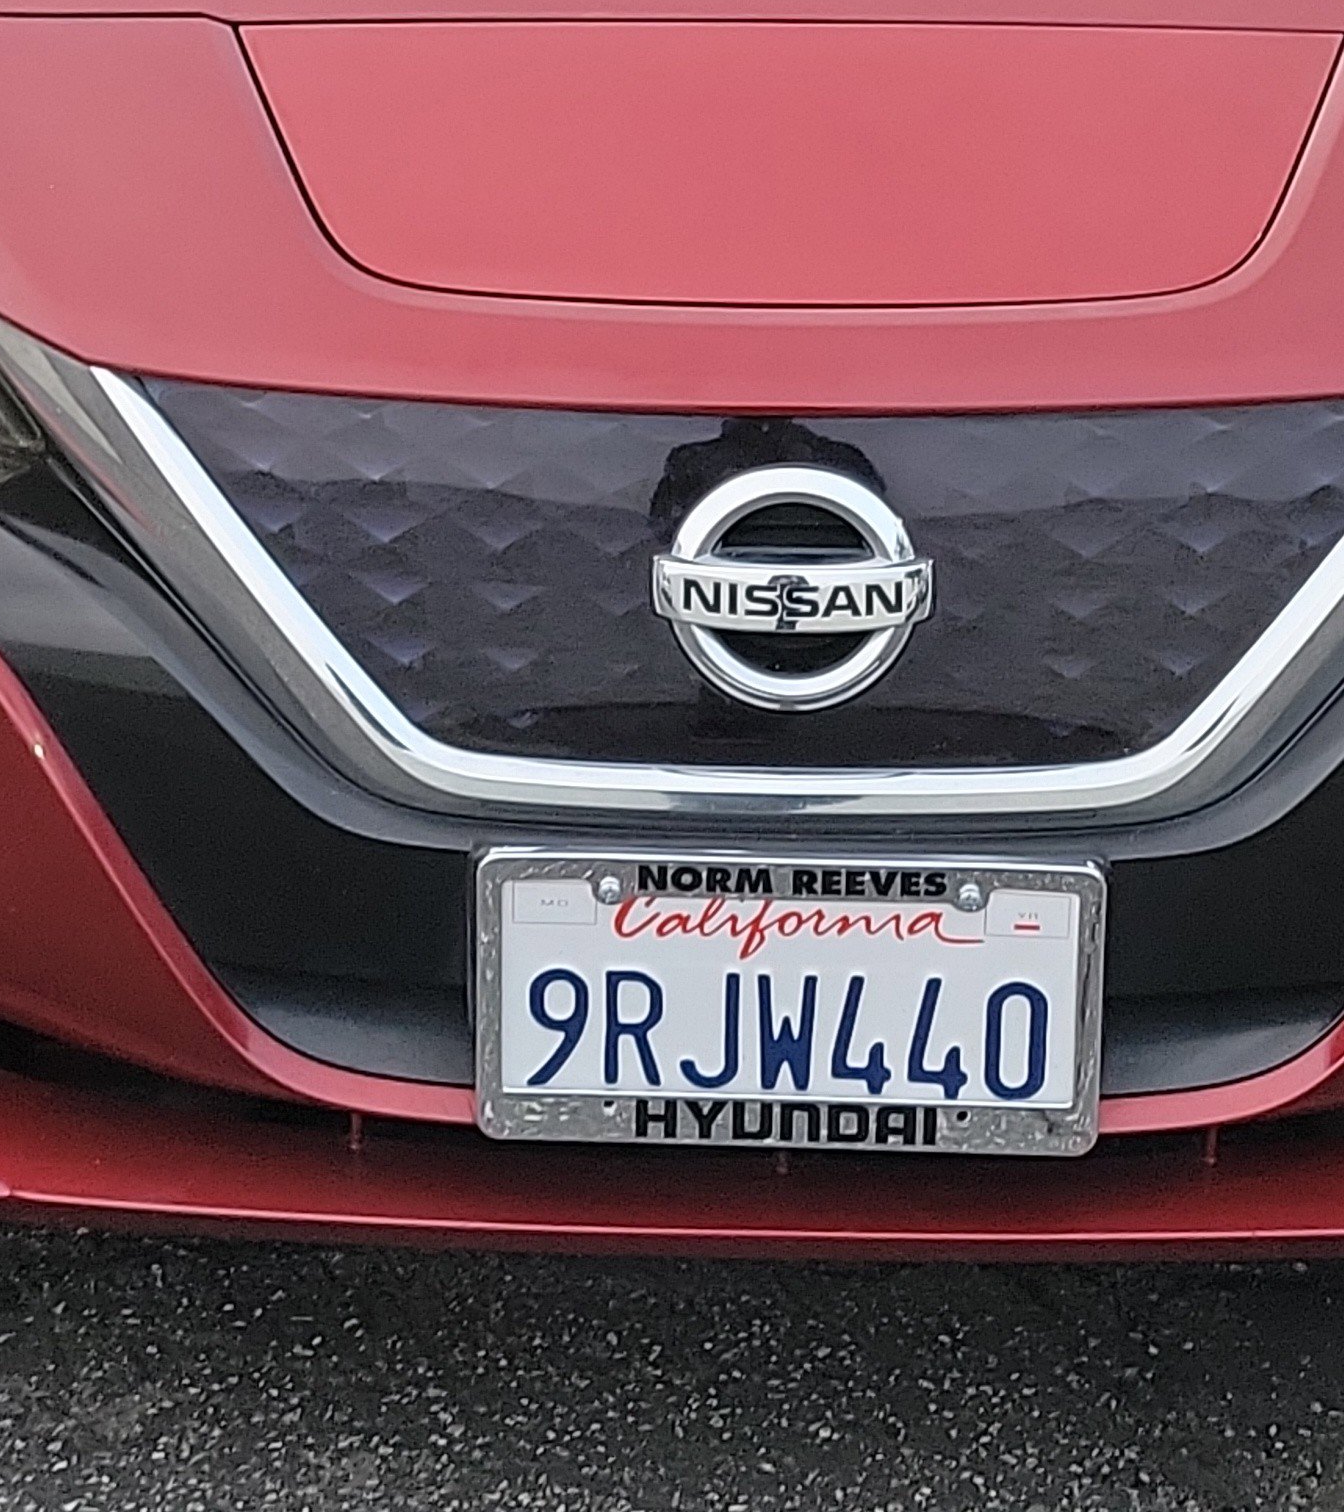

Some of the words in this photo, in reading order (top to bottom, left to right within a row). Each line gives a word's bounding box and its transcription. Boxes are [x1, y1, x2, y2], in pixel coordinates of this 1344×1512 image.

[682, 578, 904, 619] NISSAN
[637, 864, 772, 896] NORM
[791, 869, 948, 898] REEVES
[613, 895, 985, 959] California
[525, 968, 1050, 1101] 9RJW440
[634, 1099, 937, 1146] HYUNDAI
